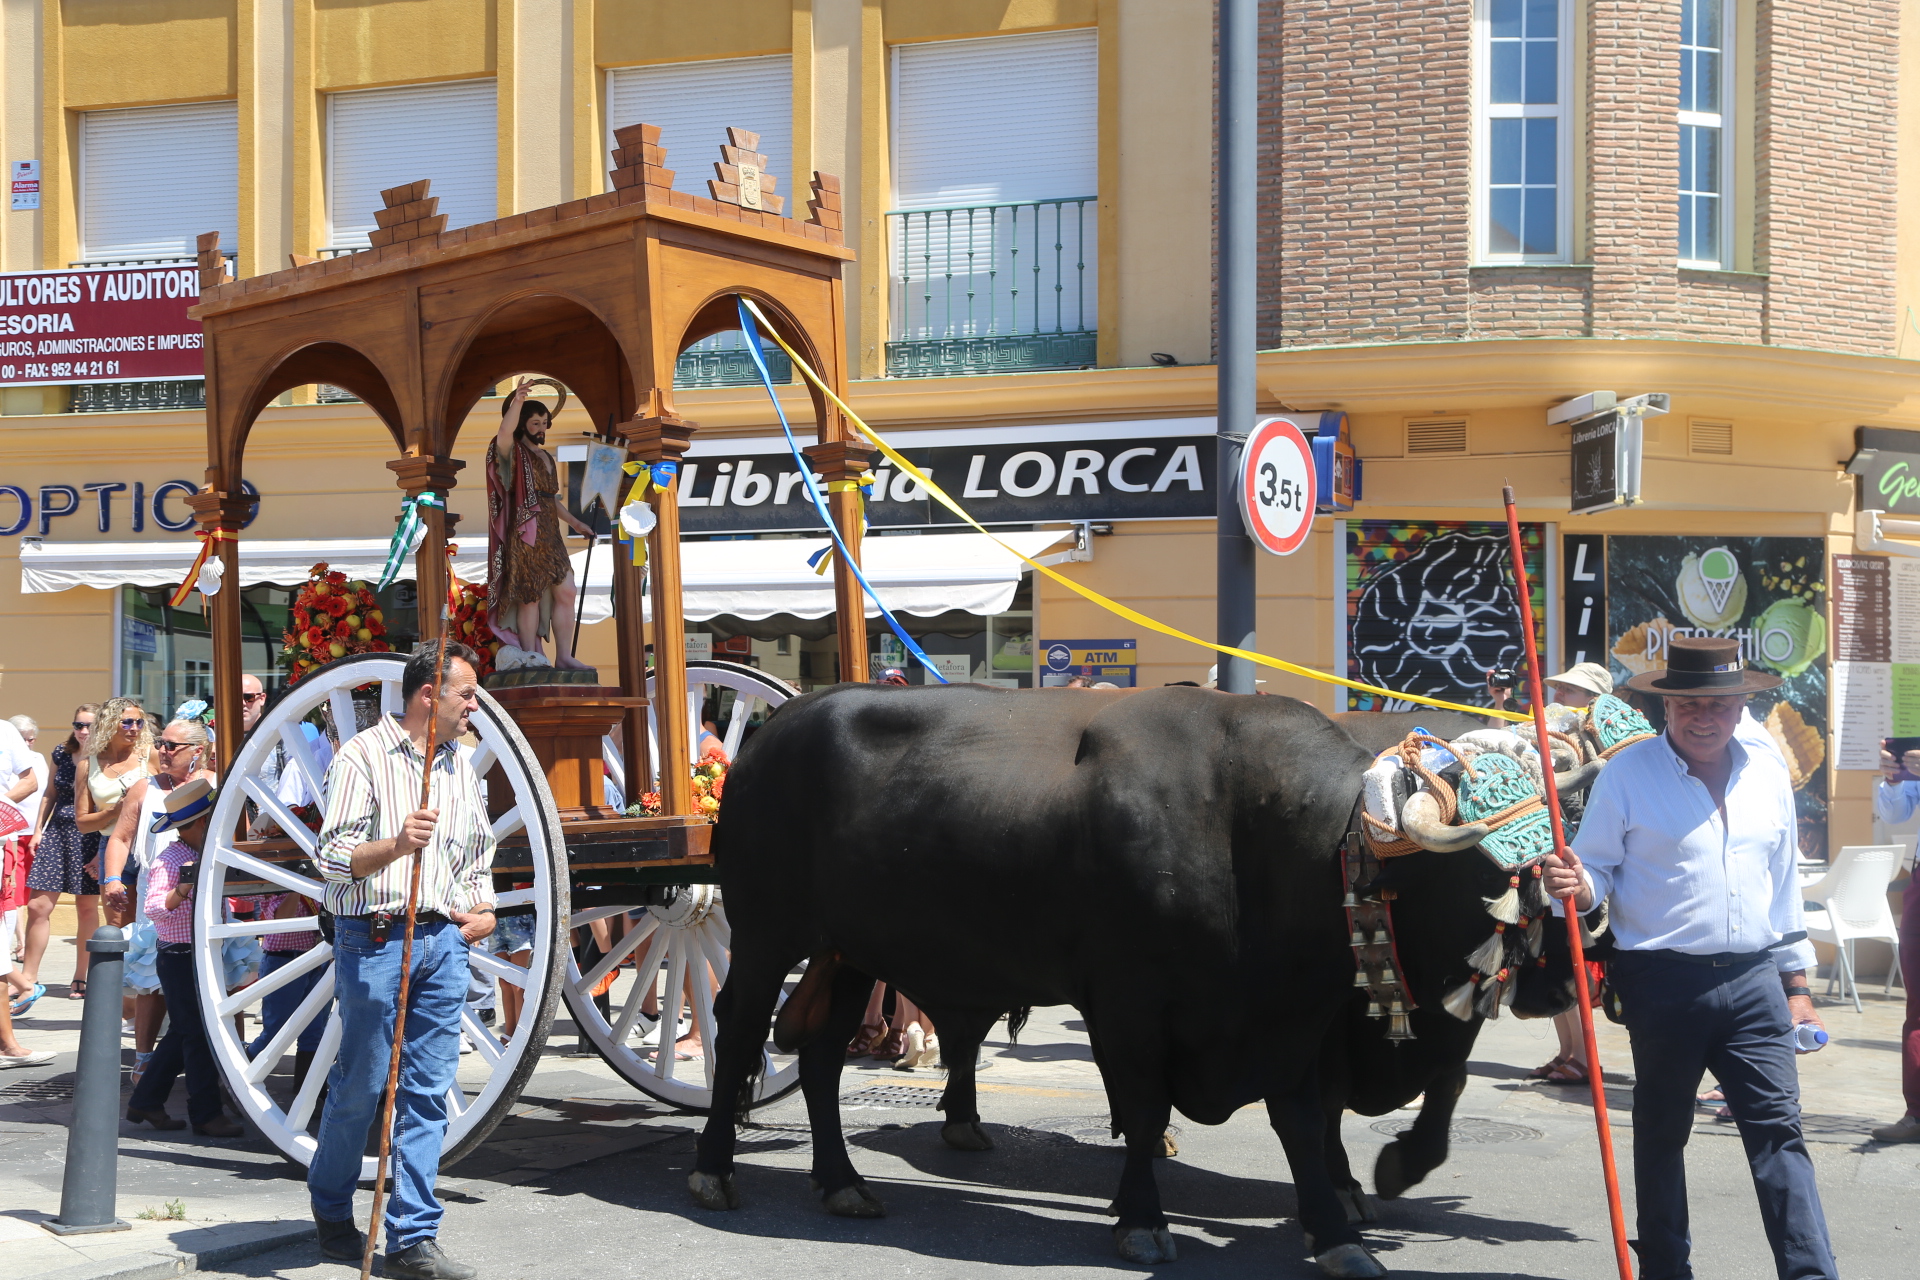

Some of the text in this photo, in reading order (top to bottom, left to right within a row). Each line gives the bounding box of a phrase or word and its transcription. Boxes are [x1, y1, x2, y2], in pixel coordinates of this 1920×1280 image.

[85, 275, 101, 302] Y
[0, 341, 35, 358] UROS,
[37, 335, 146, 355] ADMINISTRACIONES
[148, 335, 155, 350] E
[2, 365, 15, 379] 00
[25, 363, 49, 378] FAX:
[51, 362, 72, 377] 952
[73, 361, 88, 376] 44
[90, 361, 103, 375] 21
[106, 360, 119, 375] 61
[1597, 422, 1615, 436] LORCA
[963, 445, 1204, 498] LORCA
[1878, 461, 1920, 508] Ge
[1085, 652, 1118, 663] ATM
